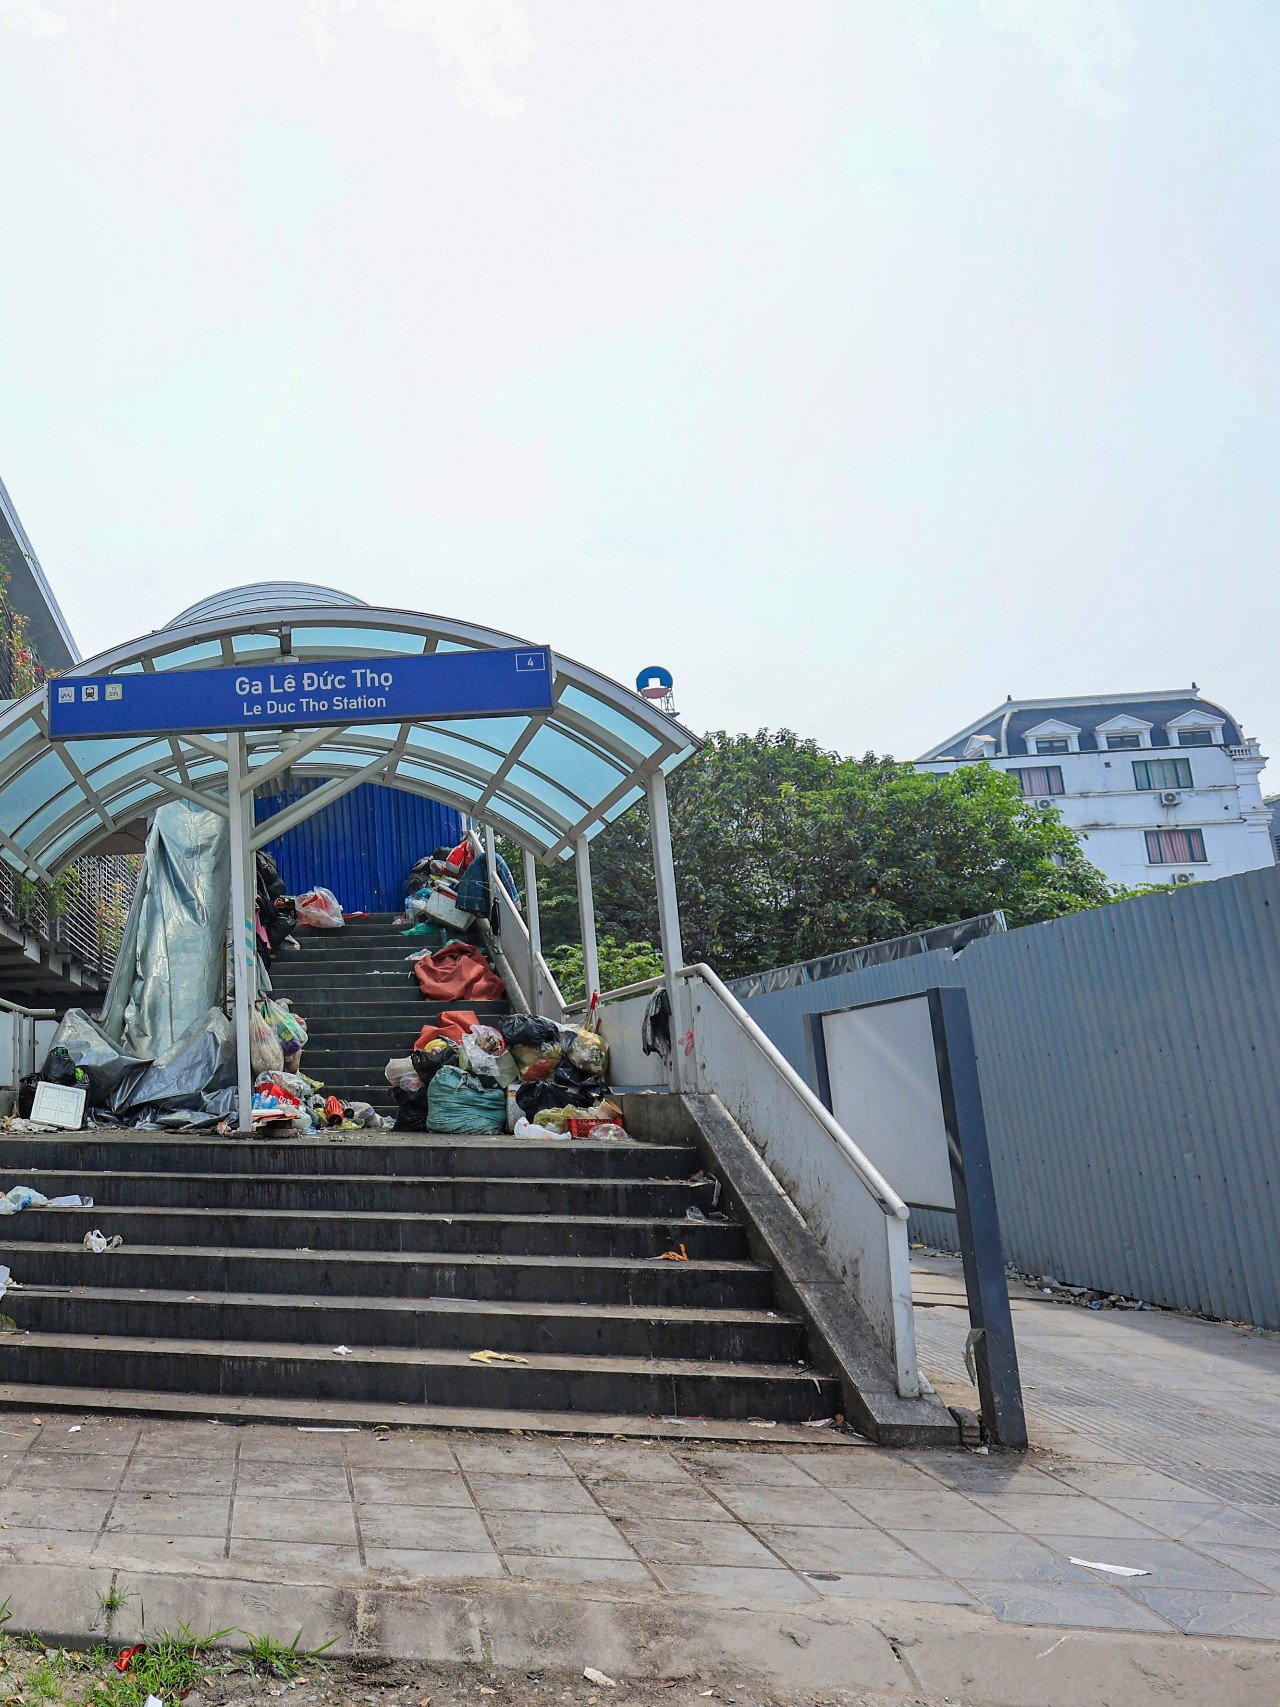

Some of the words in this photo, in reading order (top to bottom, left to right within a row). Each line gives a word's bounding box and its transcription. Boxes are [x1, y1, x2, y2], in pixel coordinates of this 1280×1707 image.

[527, 657, 534, 666] 4
[236, 677, 262, 695] Ga
[270, 674, 295, 693] Lê
[303, 671, 346, 691] Đức
[352, 669, 392, 691] Thọ
[244, 703, 261, 715] Le
[267, 701, 295, 714] Duc
[300, 698, 328, 711] Tho
[333, 695, 386, 710] Station
